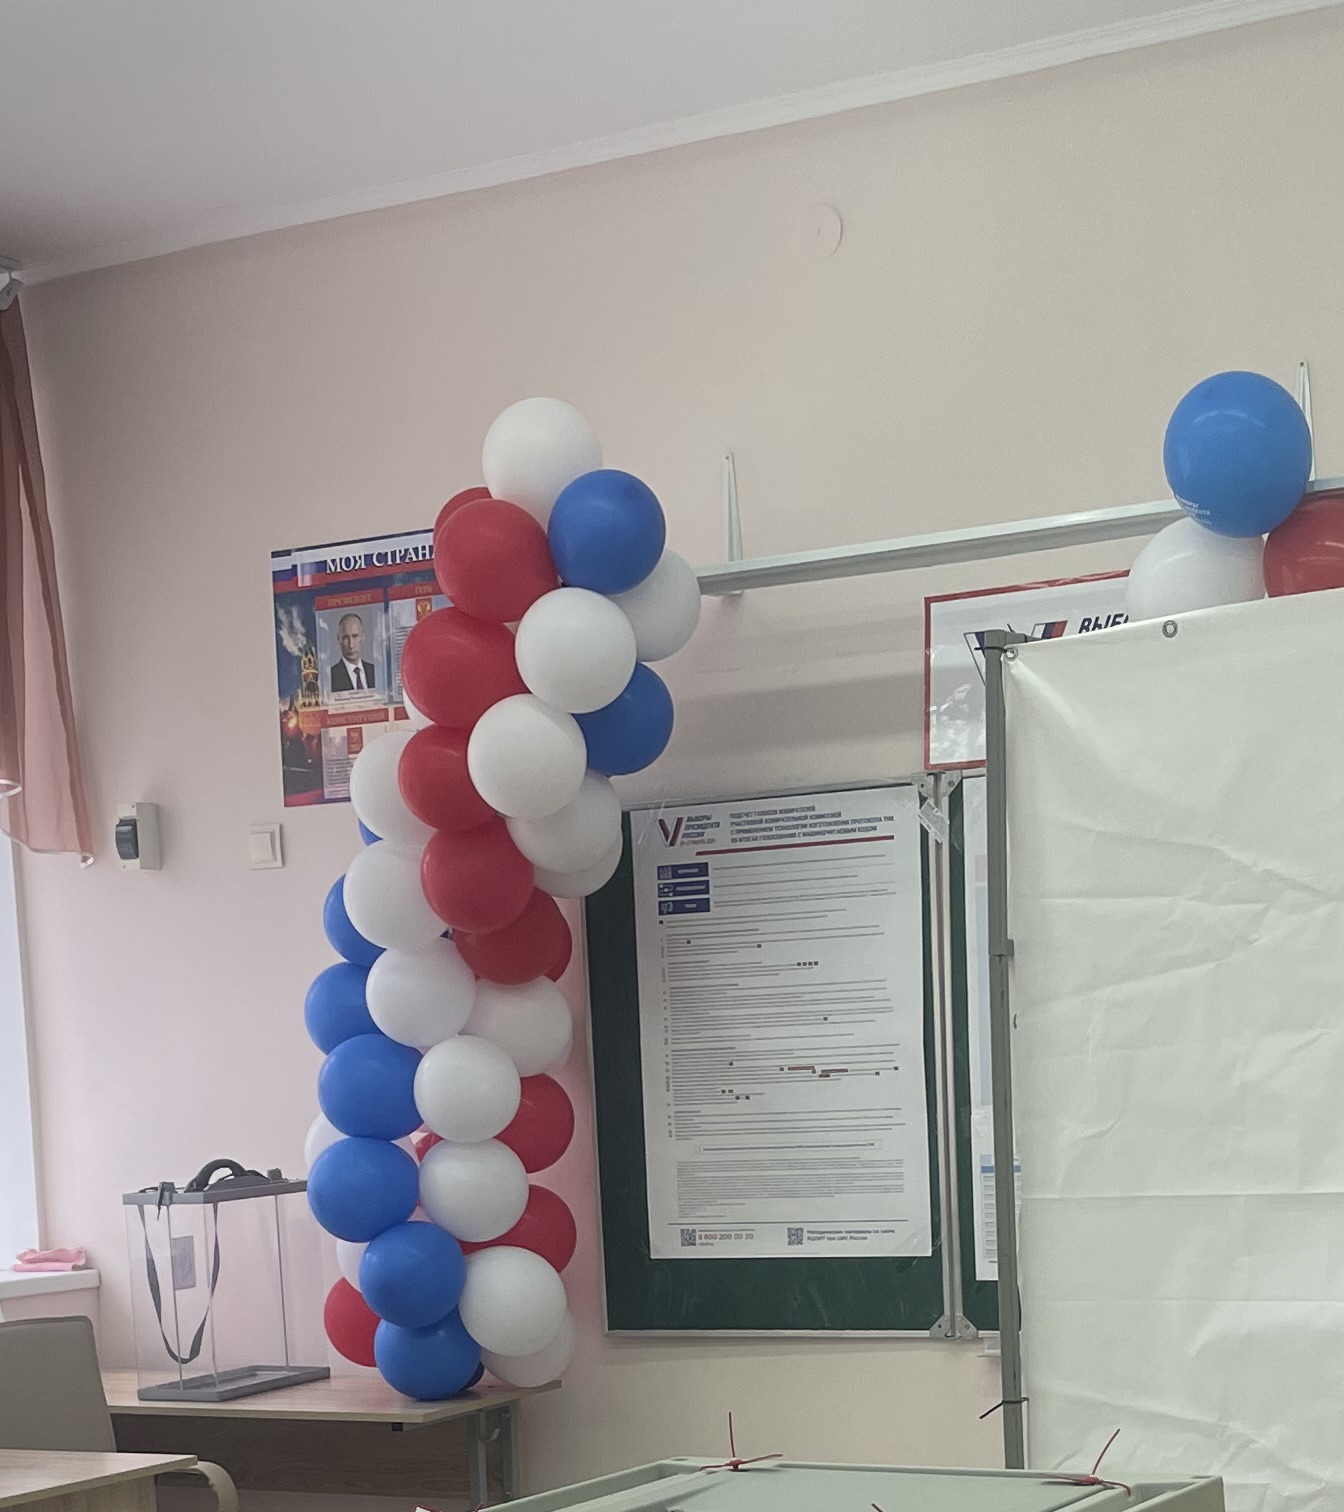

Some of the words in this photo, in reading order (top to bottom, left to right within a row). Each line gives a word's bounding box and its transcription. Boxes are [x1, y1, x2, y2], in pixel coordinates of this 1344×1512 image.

[326, 554, 367, 574] МОЯ
[373, 545, 435, 567] СТРАН
[1078, 613, 1130, 634] ВЫБ
